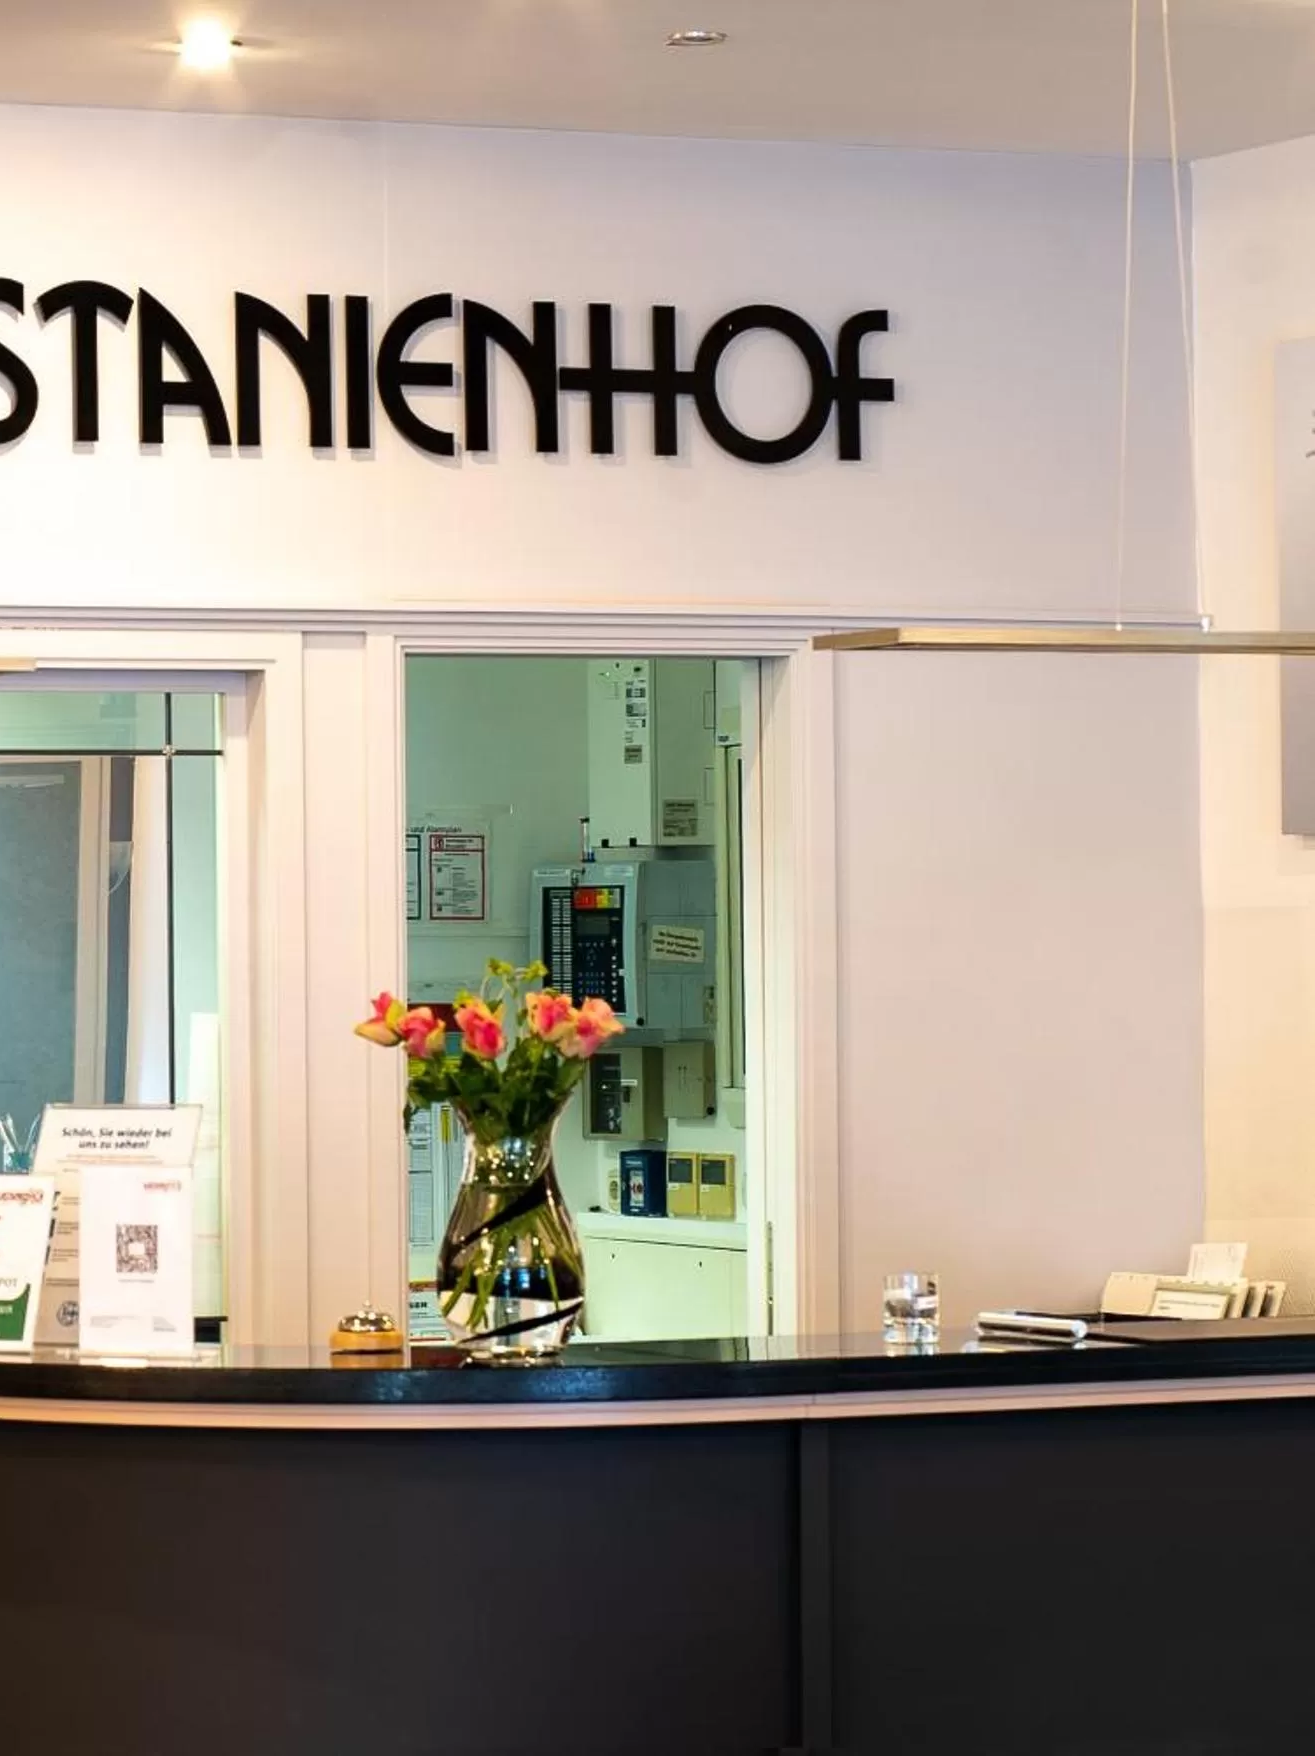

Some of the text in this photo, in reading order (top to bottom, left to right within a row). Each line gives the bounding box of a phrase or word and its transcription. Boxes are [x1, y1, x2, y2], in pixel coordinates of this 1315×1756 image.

[62, 1126, 173, 1137] Schön, Sie wieder bei
[78, 1139, 150, 1149] uns zu sehen!
